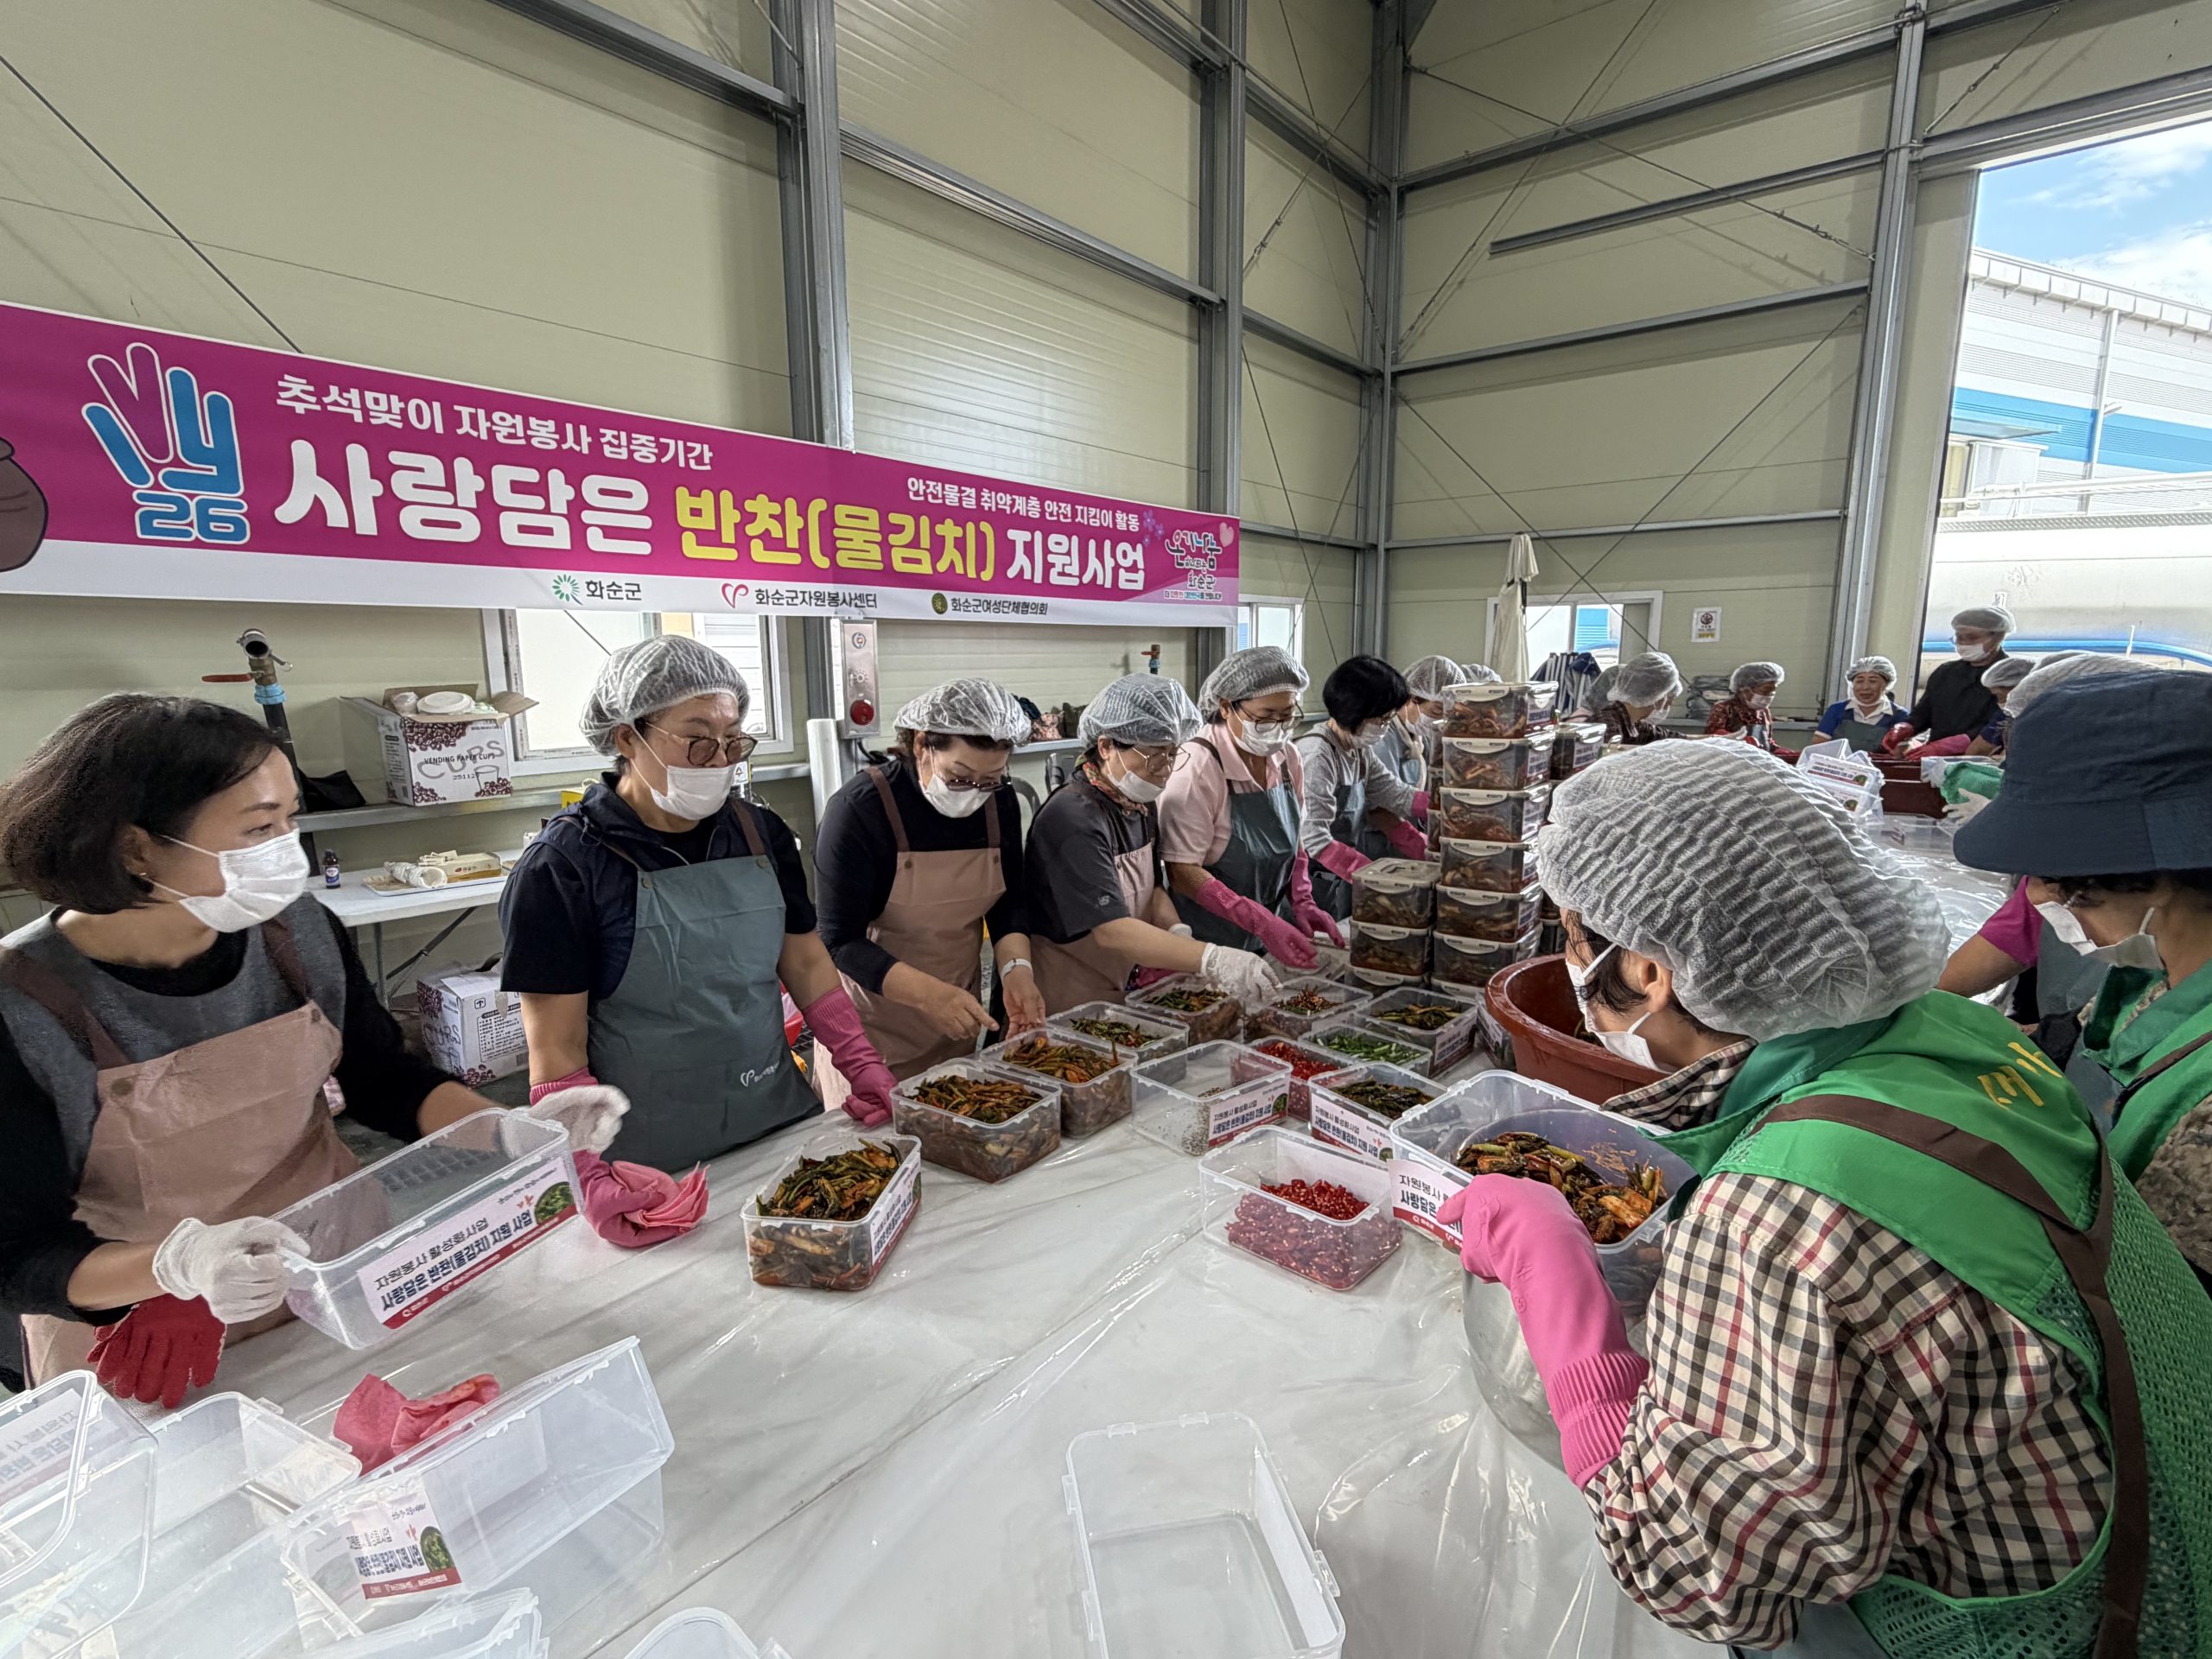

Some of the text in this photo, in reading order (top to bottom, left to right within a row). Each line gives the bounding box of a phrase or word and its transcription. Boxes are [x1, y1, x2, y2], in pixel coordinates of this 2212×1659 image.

[276, 373, 714, 471] 추석맞이 자원봉사 집중기간
[133, 490, 251, 544] 26
[274, 439, 1146, 591] 사랑담은 반찬(물김치) 지원사업
[907, 477, 1140, 532] 안전물결 취약계층 안전 지킴이 활동
[585, 580, 642, 601] 화순군
[1187, 570, 1216, 590] 화순군
[754, 588, 878, 609] 화순군자원봉사센터
[950, 597, 1048, 616] 화순군여성단체협의회
[416, 741, 505, 779] CUPS
[423, 755, 455, 764] VENDING
[456, 753, 478, 762] PAPER
[1399, 1174, 1441, 1201] 자원봉사
[1401, 1190, 1438, 1219] 사랑담은
[374, 1254, 428, 1290] 자원봉사
[429, 1217, 490, 1260] 활성화사업
[380, 1274, 429, 1312] 사랑담은
[427, 1238, 492, 1282] 반찬(물김치)
[492, 1224, 513, 1247] 지원
[512, 1209, 534, 1230] 사업
